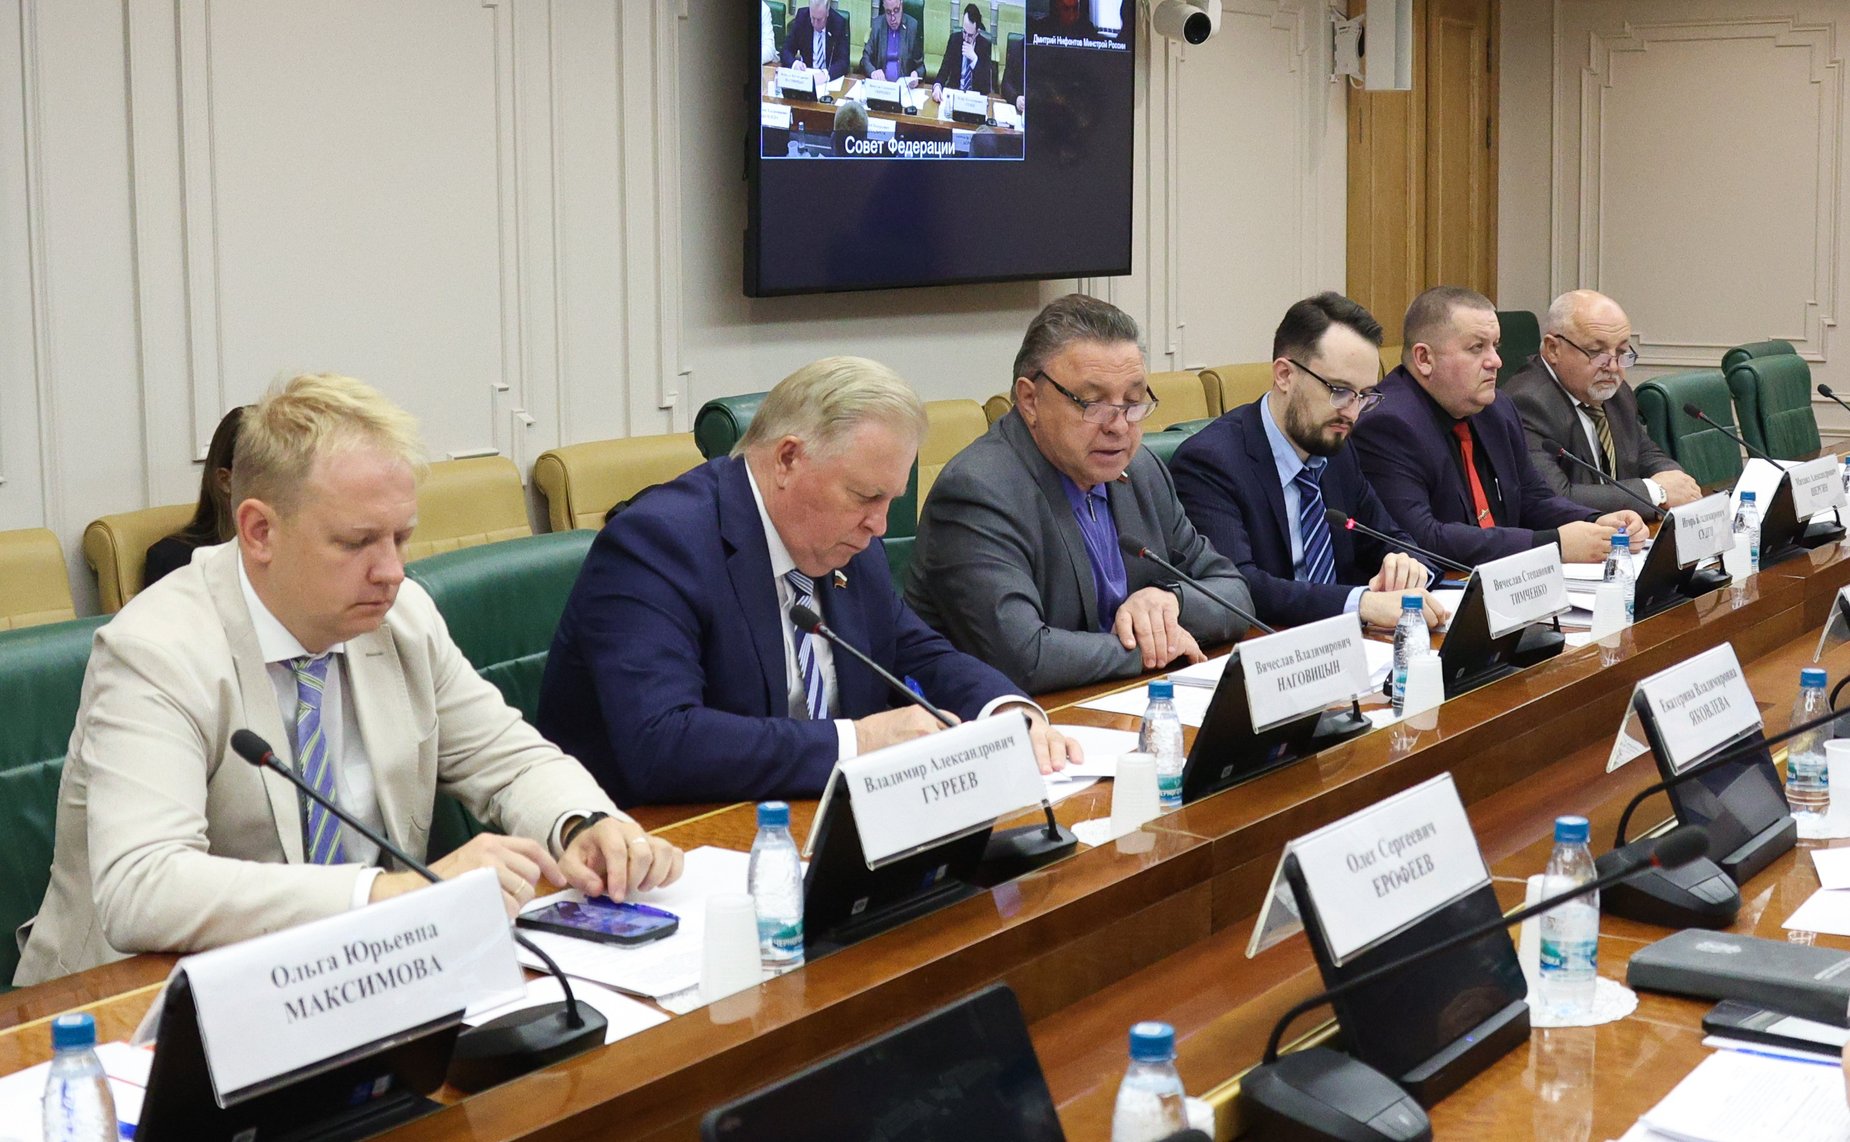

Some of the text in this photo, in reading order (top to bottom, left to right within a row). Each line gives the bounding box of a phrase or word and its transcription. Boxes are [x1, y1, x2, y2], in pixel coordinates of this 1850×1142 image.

[844, 135, 884, 154] Совет
[887, 136, 956, 158] Федерации
[1493, 565, 1555, 591] Вячеслав Степанович
[1510, 584, 1548, 606] ТИМЧЕНКО
[1255, 638, 1352, 675] Вячеслав Владимирович
[1277, 660, 1340, 692] НАГОВИЦЫН
[1659, 668, 1738, 713] Екатерина Владимировна
[1689, 696, 1731, 727] ЯКОВЛЕВА
[864, 736, 1016, 793] Владимир Александрович
[922, 771, 979, 804] ГУРЕЕВ
[1346, 822, 1437, 873] Олег Сергеевич
[1372, 853, 1435, 898] ЕРОФЕЕВ
[270, 923, 439, 988] Ольга Юрьевна
[284, 954, 443, 1024] МАКСИМОВА
